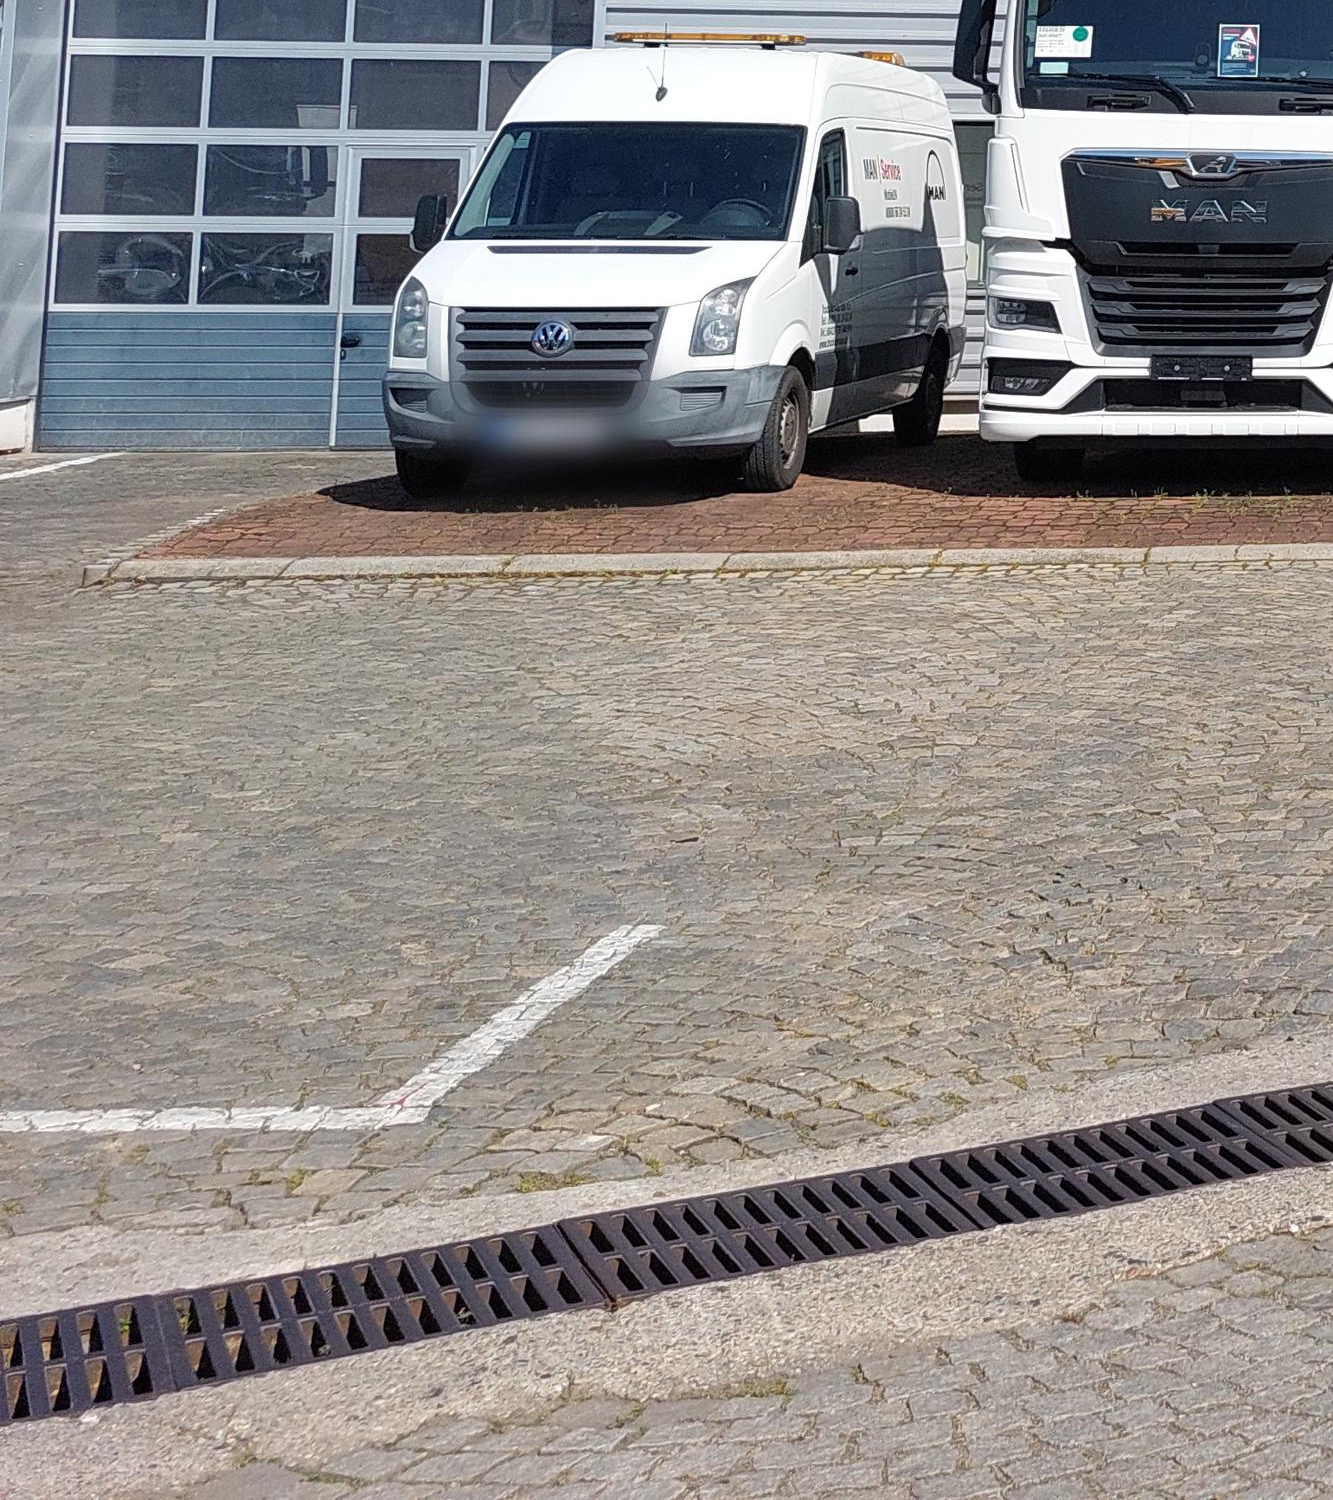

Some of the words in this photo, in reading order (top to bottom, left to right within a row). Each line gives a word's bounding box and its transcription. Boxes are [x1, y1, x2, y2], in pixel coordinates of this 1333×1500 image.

[863, 158, 878, 180] MAN
[880, 158, 901, 181] Service
[927, 186, 945, 201] MAN
[1150, 199, 1268, 223] MAN
